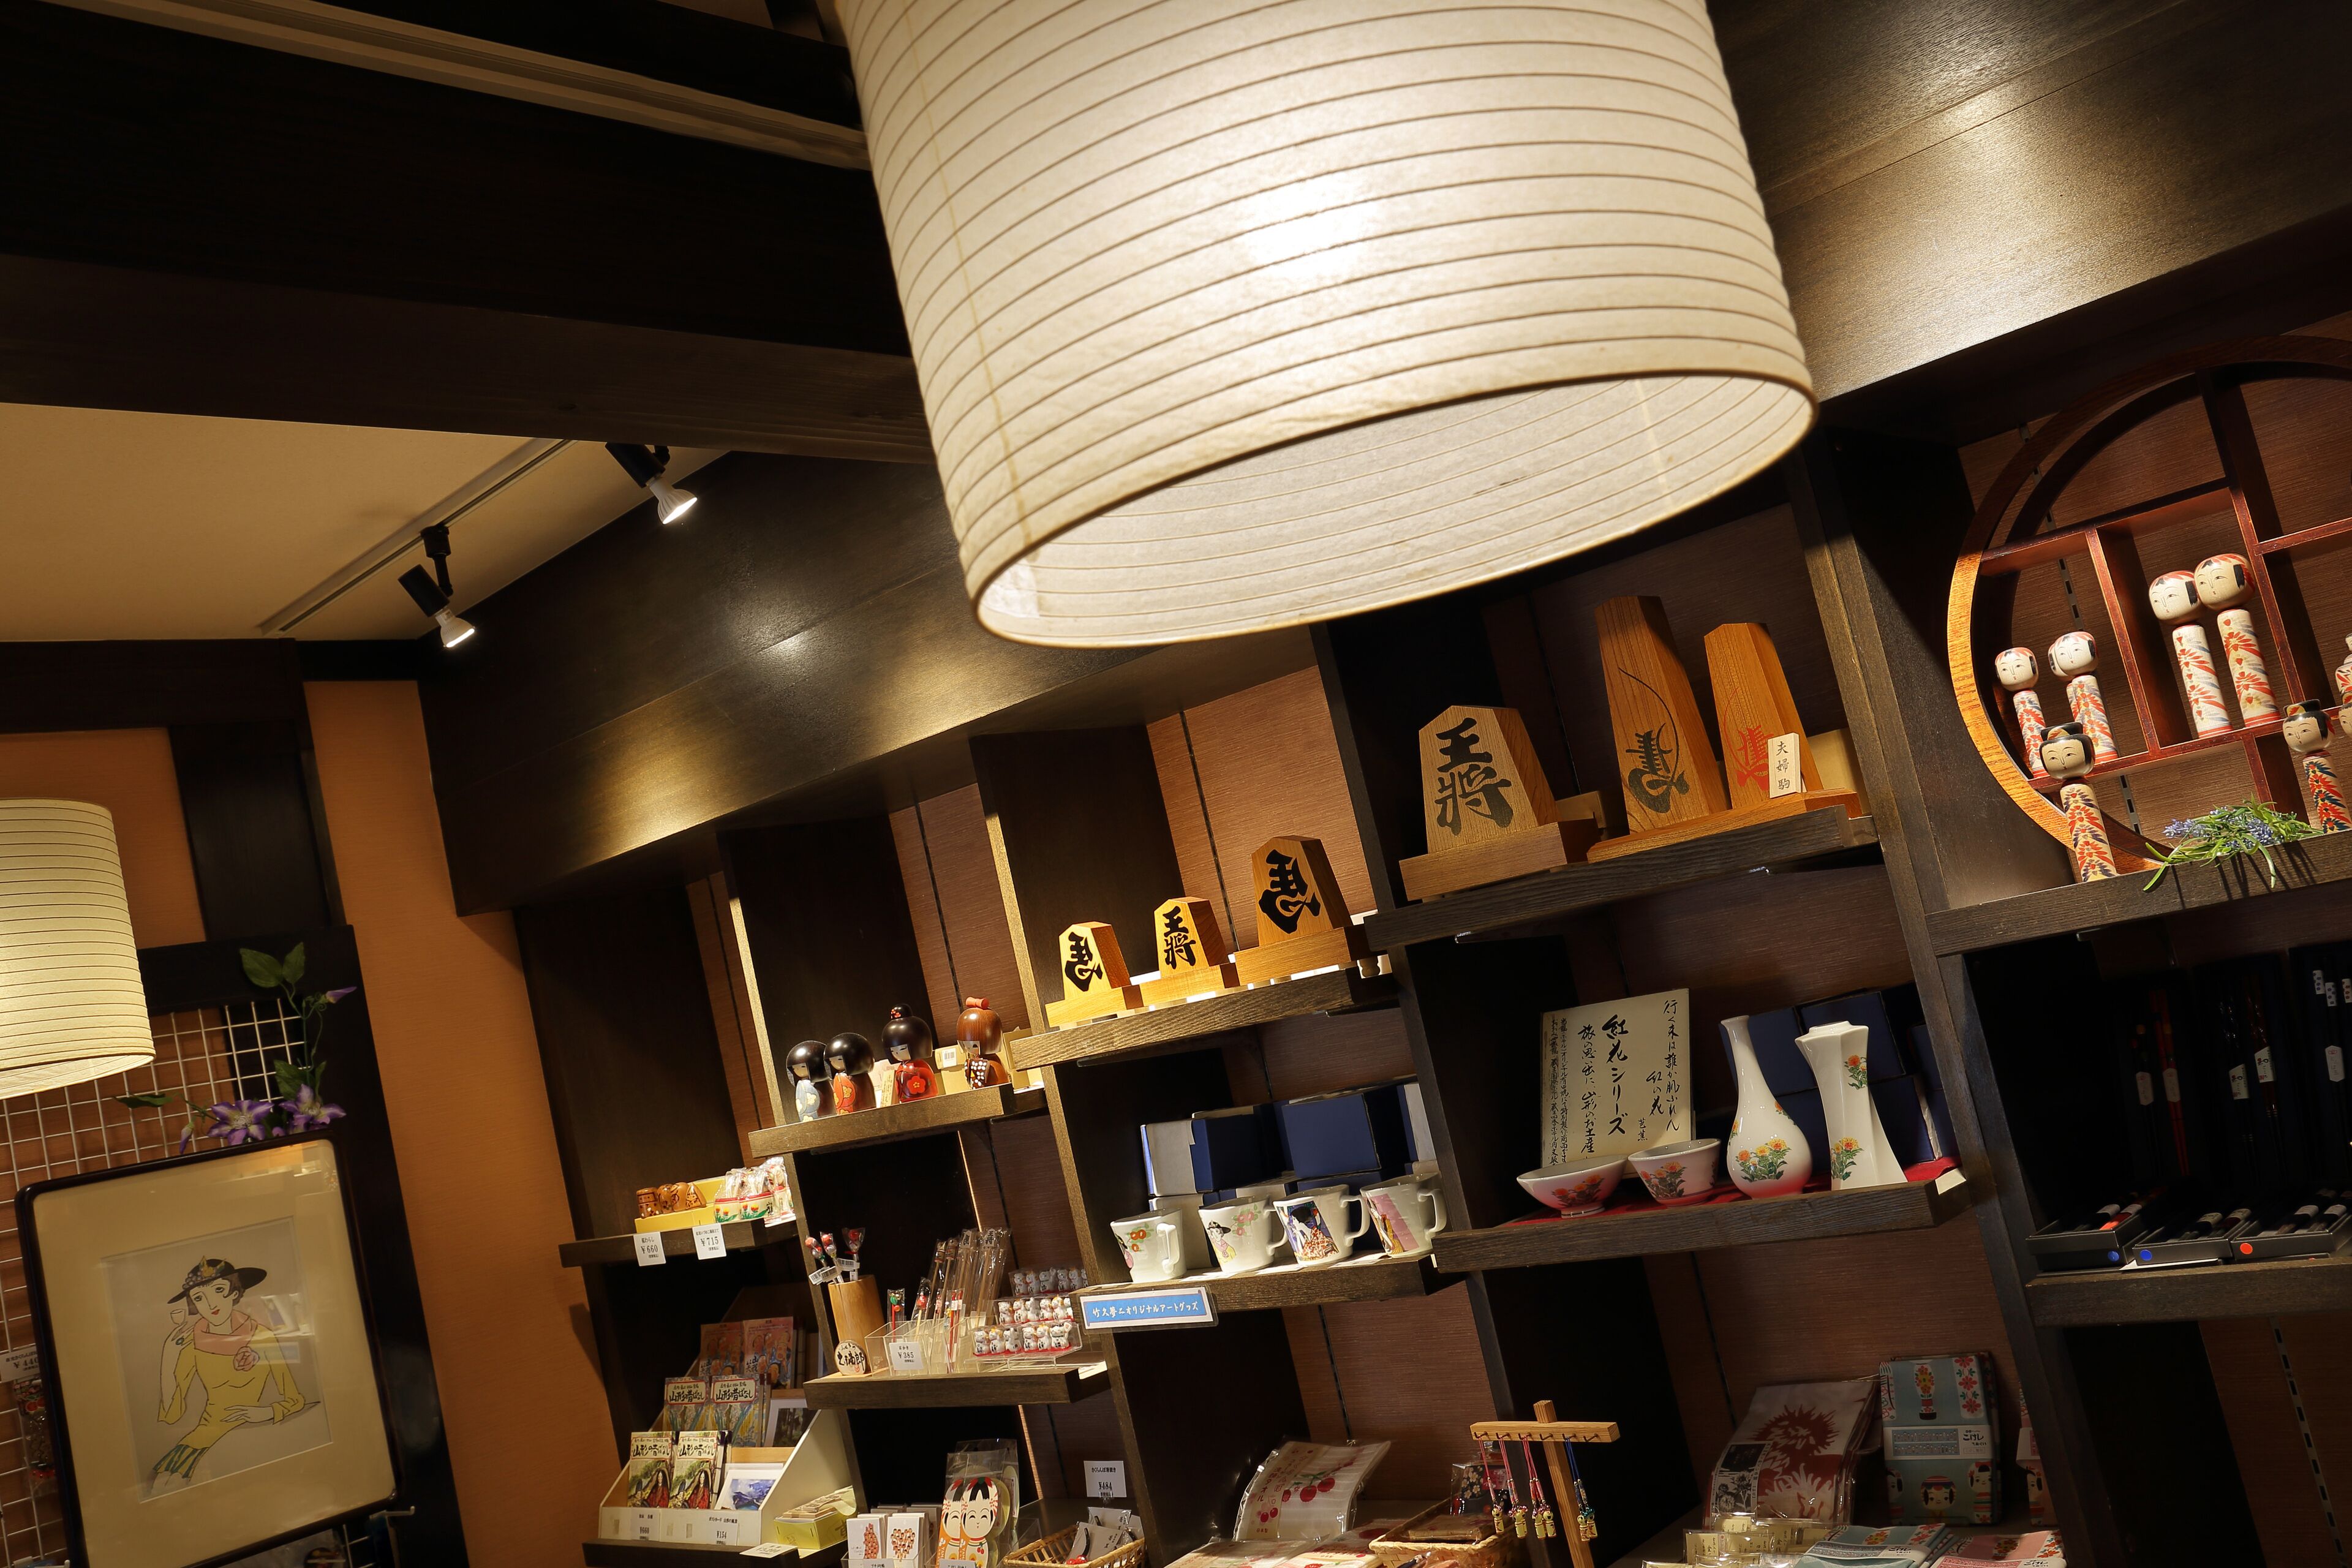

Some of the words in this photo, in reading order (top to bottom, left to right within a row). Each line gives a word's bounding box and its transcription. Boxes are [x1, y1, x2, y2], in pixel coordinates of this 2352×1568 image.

[1776, 741, 1792, 791] 夫婦駒
[1602, 1014, 1629, 1136] 紅花シリーズ
[1637, 1118, 1648, 1142] 芭蕉
[1092, 1301, 1199, 1319] 竹久夢二オリジナルアートグッズ
[1098, 1482, 1112, 1490] ¥484
